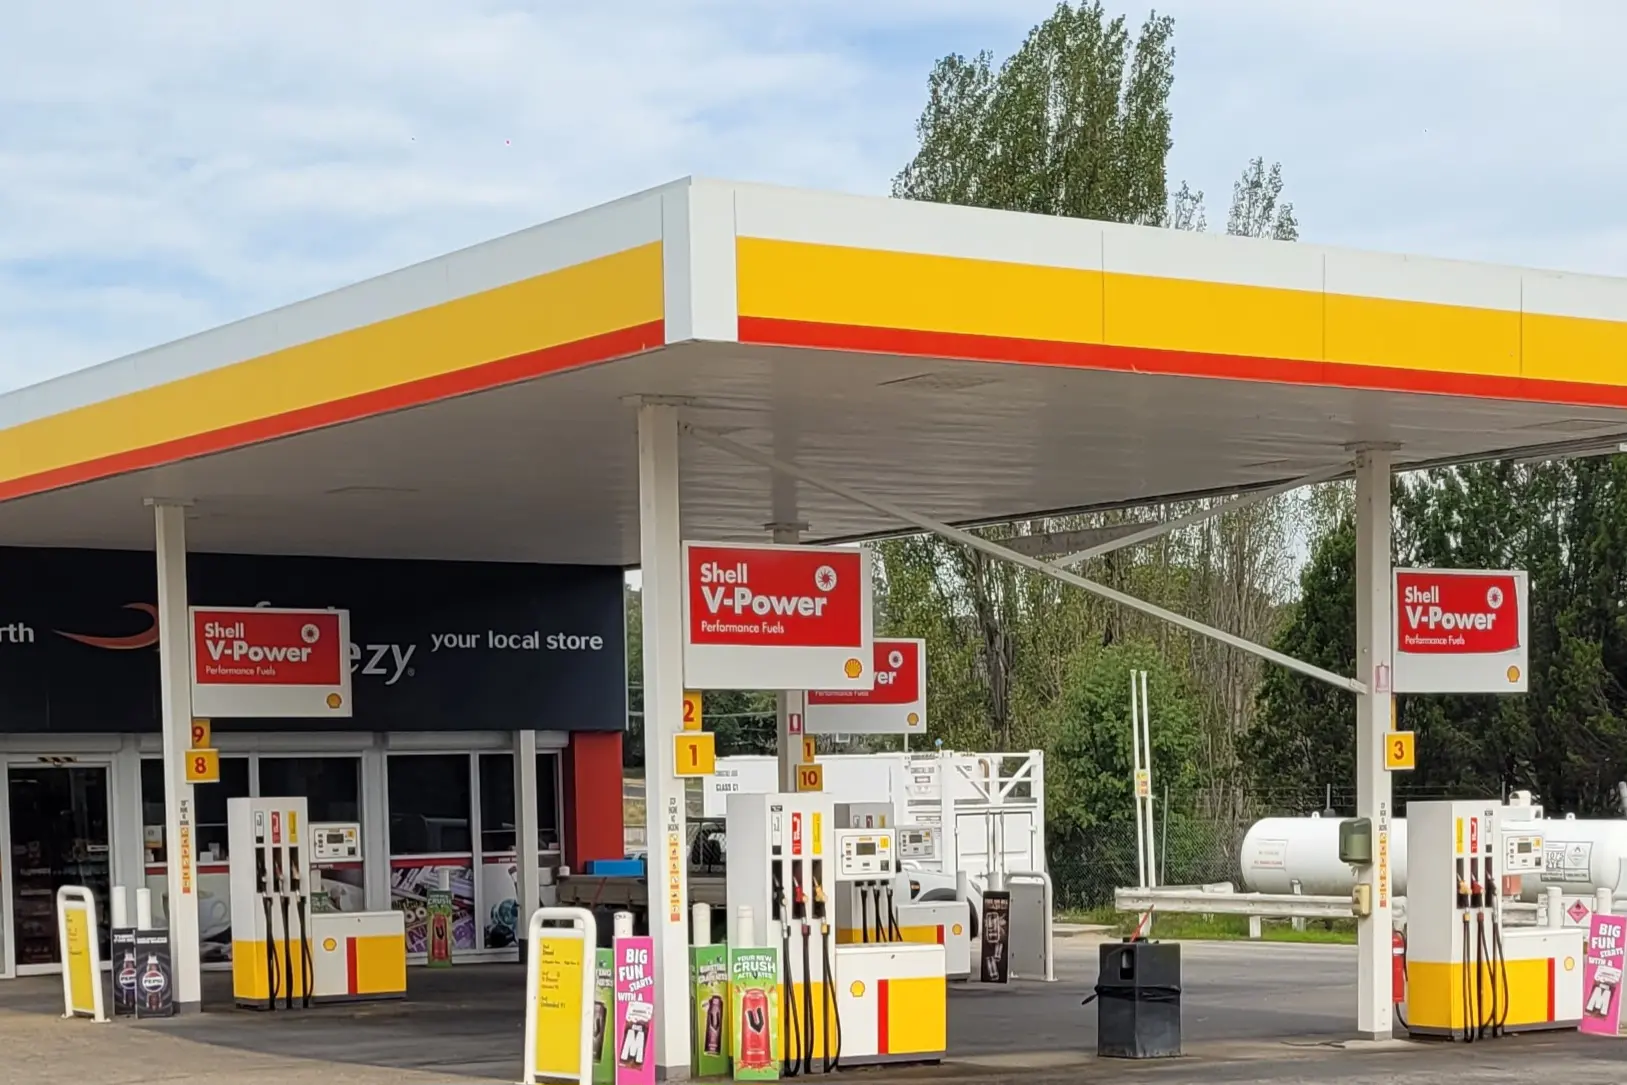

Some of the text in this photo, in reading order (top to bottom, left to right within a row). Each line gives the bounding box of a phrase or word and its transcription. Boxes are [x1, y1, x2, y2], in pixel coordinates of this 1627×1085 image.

[700, 562, 748, 584] Shell
[701, 586, 827, 616] V-Power
[1405, 585, 1439, 603] Shell
[1405, 606, 1496, 630] V-Power
[204, 622, 244, 639] Shell
[701, 620, 784, 634] Performance Fuels
[431, 630, 603, 652] your local store
[1405, 633, 1465, 645] Performance Fuels
[206, 640, 312, 662] V-Power
[205, 665, 276, 676] Performance Fuels
[683, 700, 695, 722] 2
[192, 726, 204, 742] 9
[689, 744, 698, 766] 1
[1393, 740, 1404, 760] 3
[194, 757, 207, 774] 8
[801, 770, 818, 786] 10
[1599, 923, 1621, 938] BIG
[1591, 936, 1616, 949] FUN
[626, 948, 648, 964] BIG
[618, 964, 644, 982] FUN
[733, 961, 776, 973] CRUSH
[629, 976, 653, 992] STARTS
[617, 991, 643, 1002] WITH A
